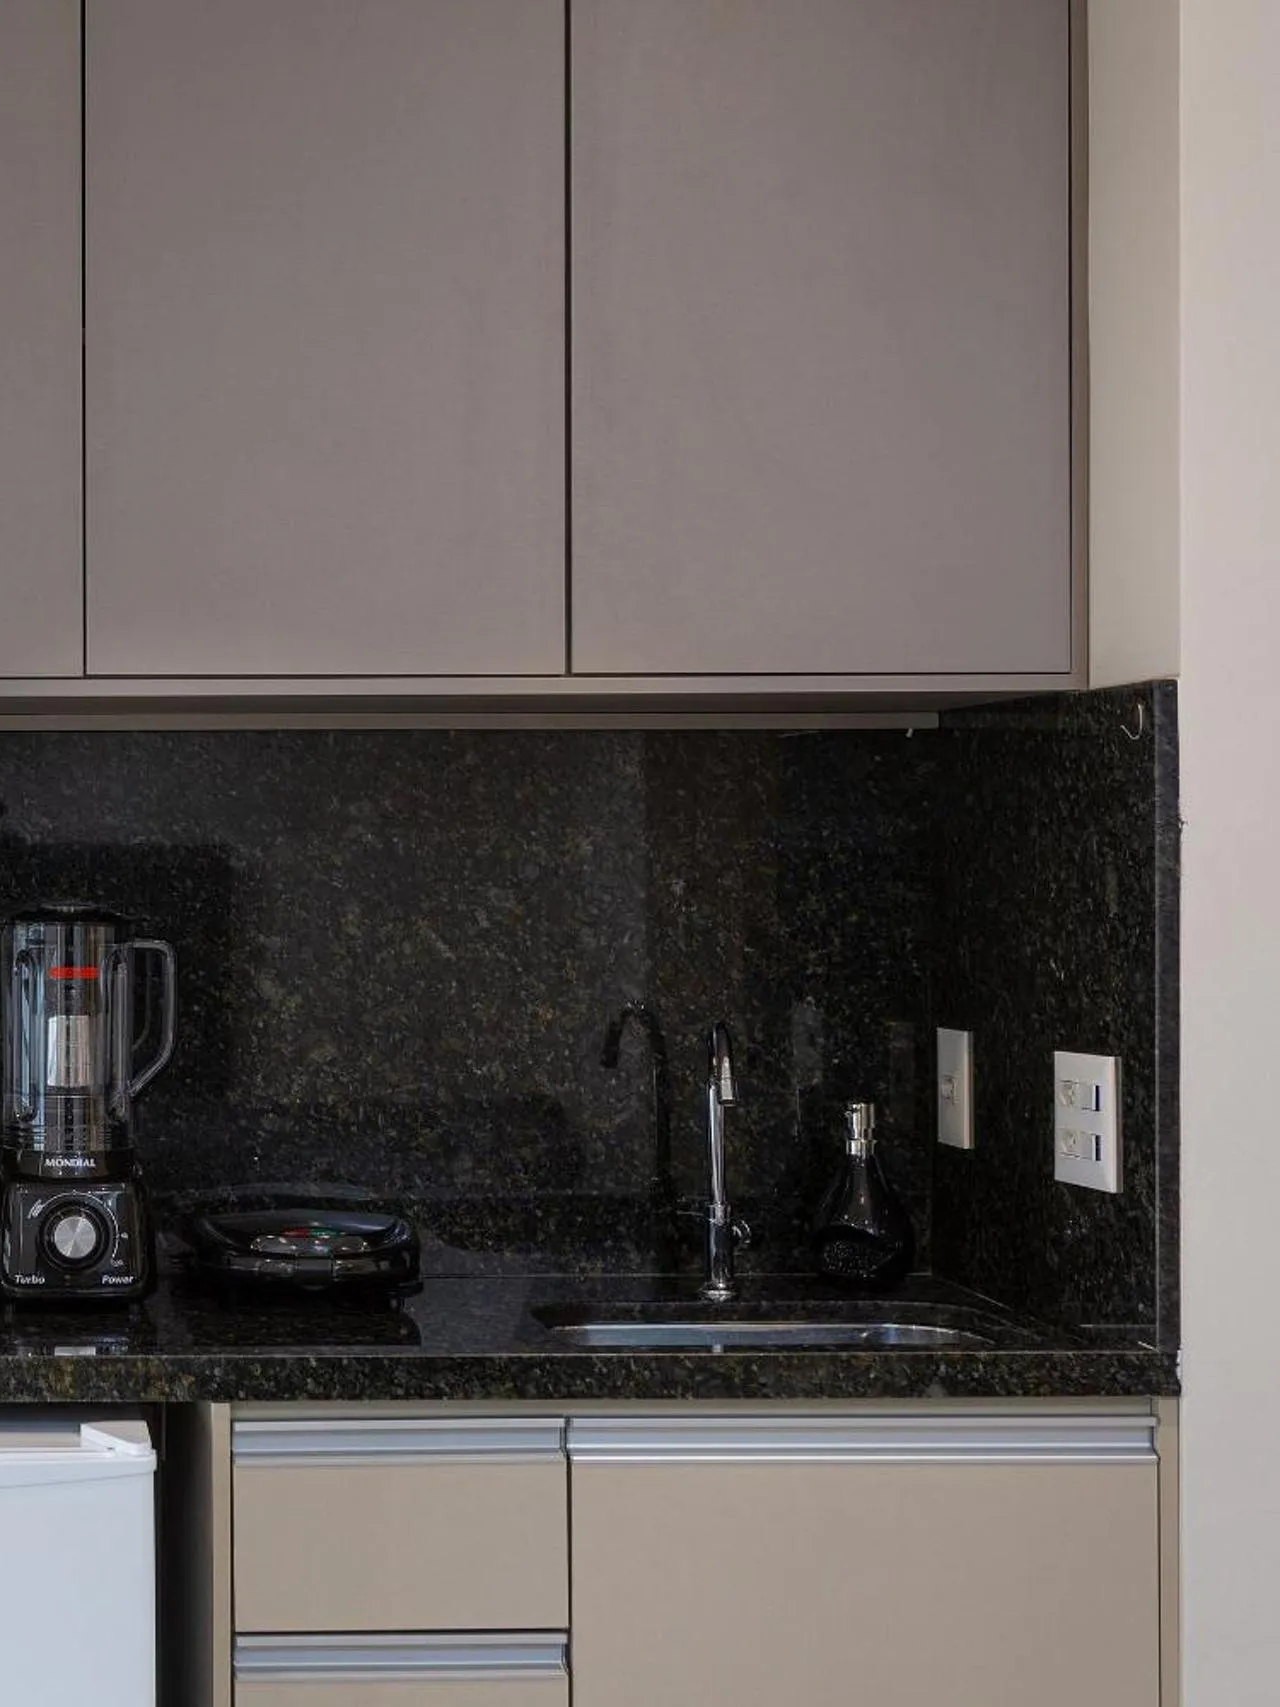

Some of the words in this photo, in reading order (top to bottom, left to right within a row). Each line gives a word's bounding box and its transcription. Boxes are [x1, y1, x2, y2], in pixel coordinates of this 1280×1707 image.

[44, 1158, 97, 1168] MONDIAL
[14, 1274, 46, 1285] Turbo
[102, 1274, 134, 1285] Power
